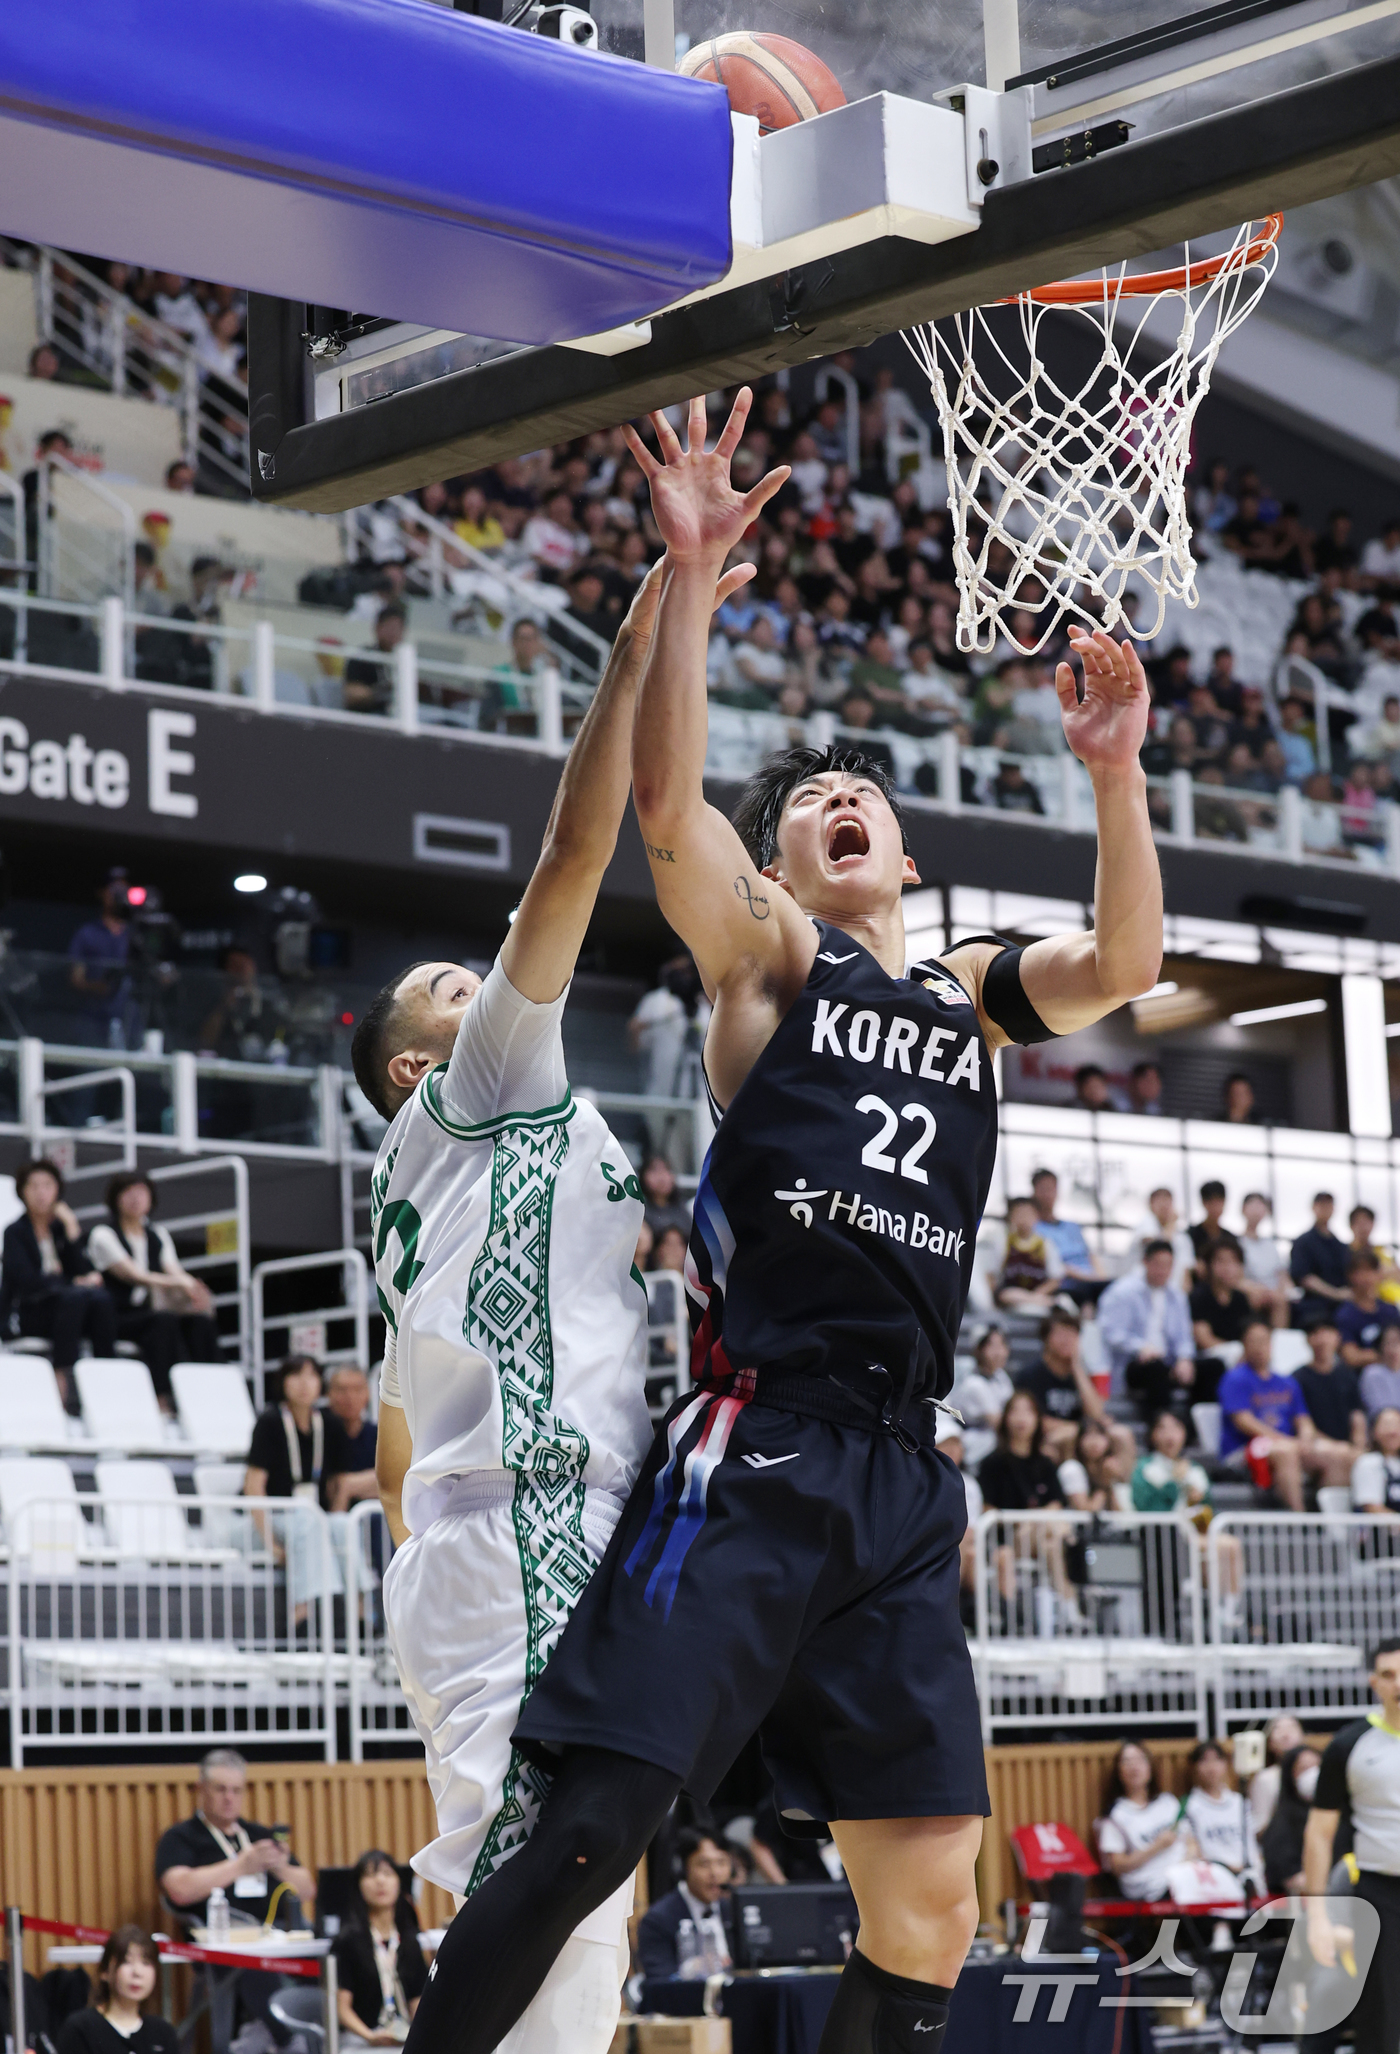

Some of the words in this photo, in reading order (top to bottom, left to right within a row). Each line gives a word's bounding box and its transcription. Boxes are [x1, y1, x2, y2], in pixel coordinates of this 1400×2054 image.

[0, 716, 129, 809] Gate
[147, 707, 198, 819] E
[811, 998, 981, 1092] KOREA
[600, 1161, 645, 1204] Sa
[855, 1093, 937, 1185] 22
